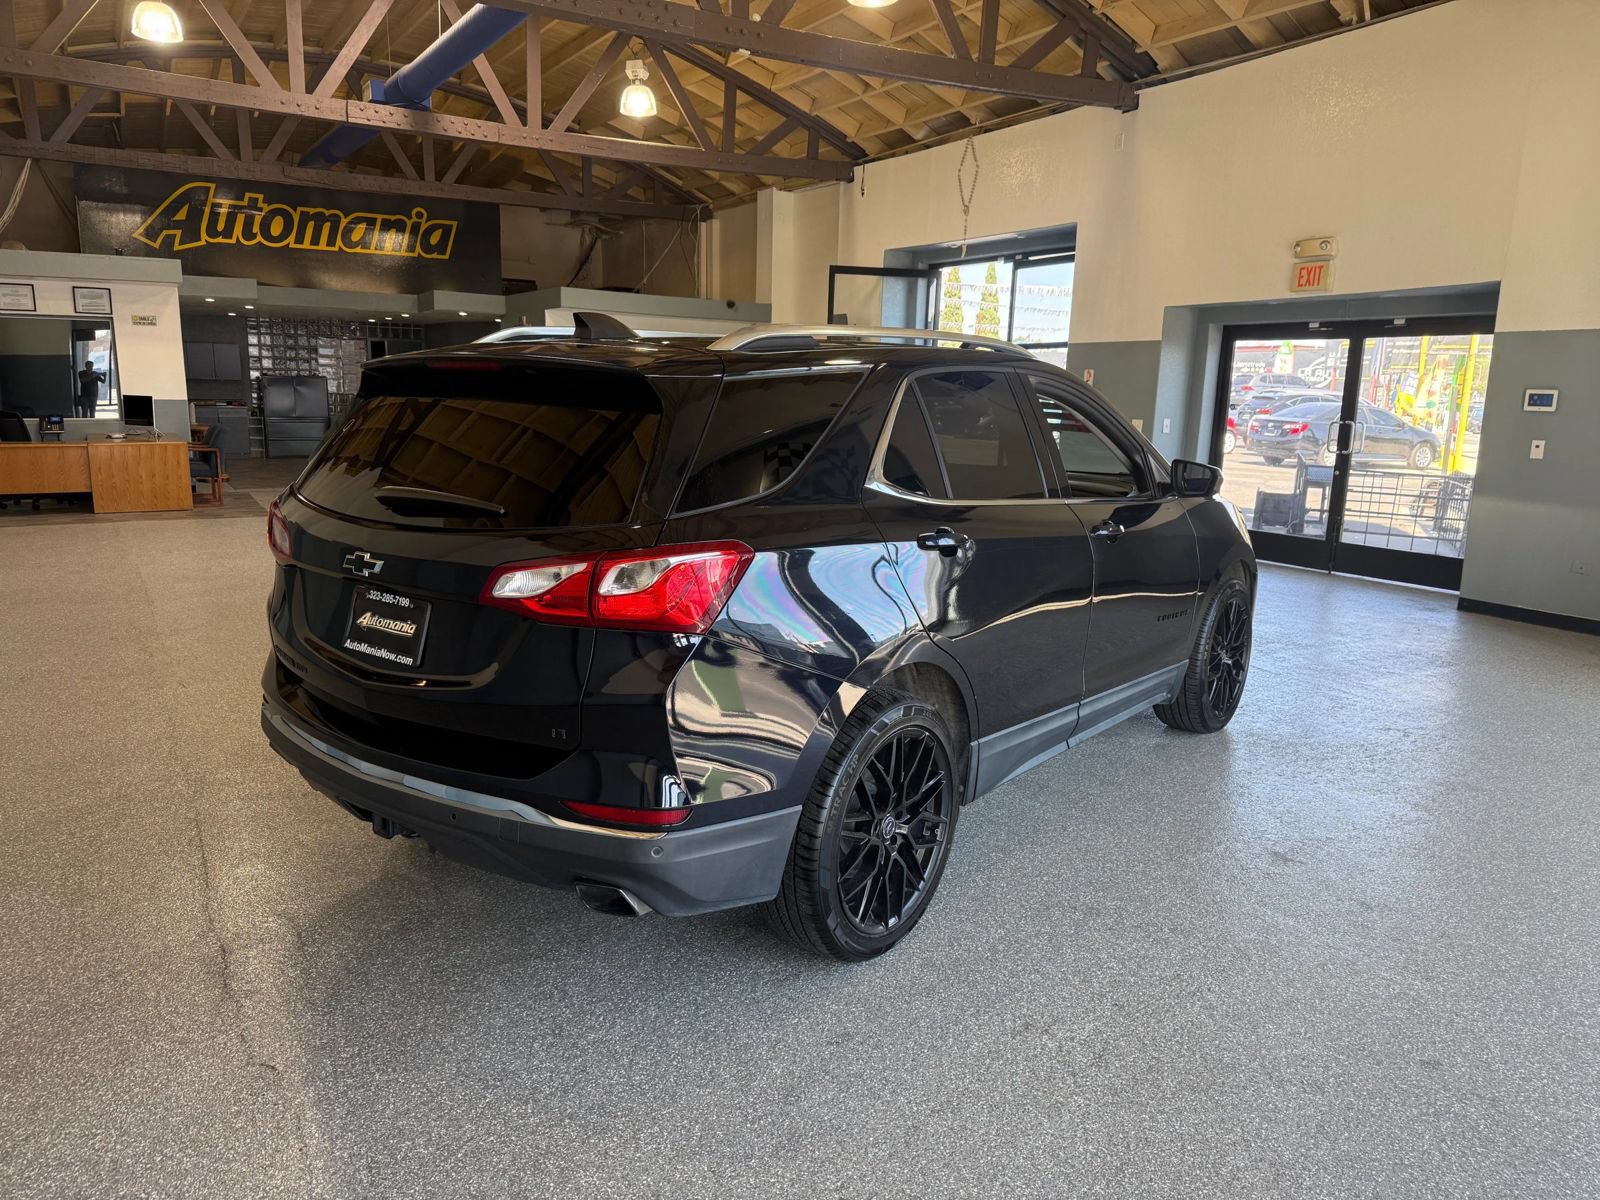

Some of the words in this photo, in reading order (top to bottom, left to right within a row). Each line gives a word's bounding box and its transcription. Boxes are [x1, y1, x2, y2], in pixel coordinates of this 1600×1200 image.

[132, 182, 457, 259] Automania
[1297, 265, 1324, 288] EXIT
[357, 611, 416, 634] Automania
[344, 638, 413, 666] AutoManiaNow.com
